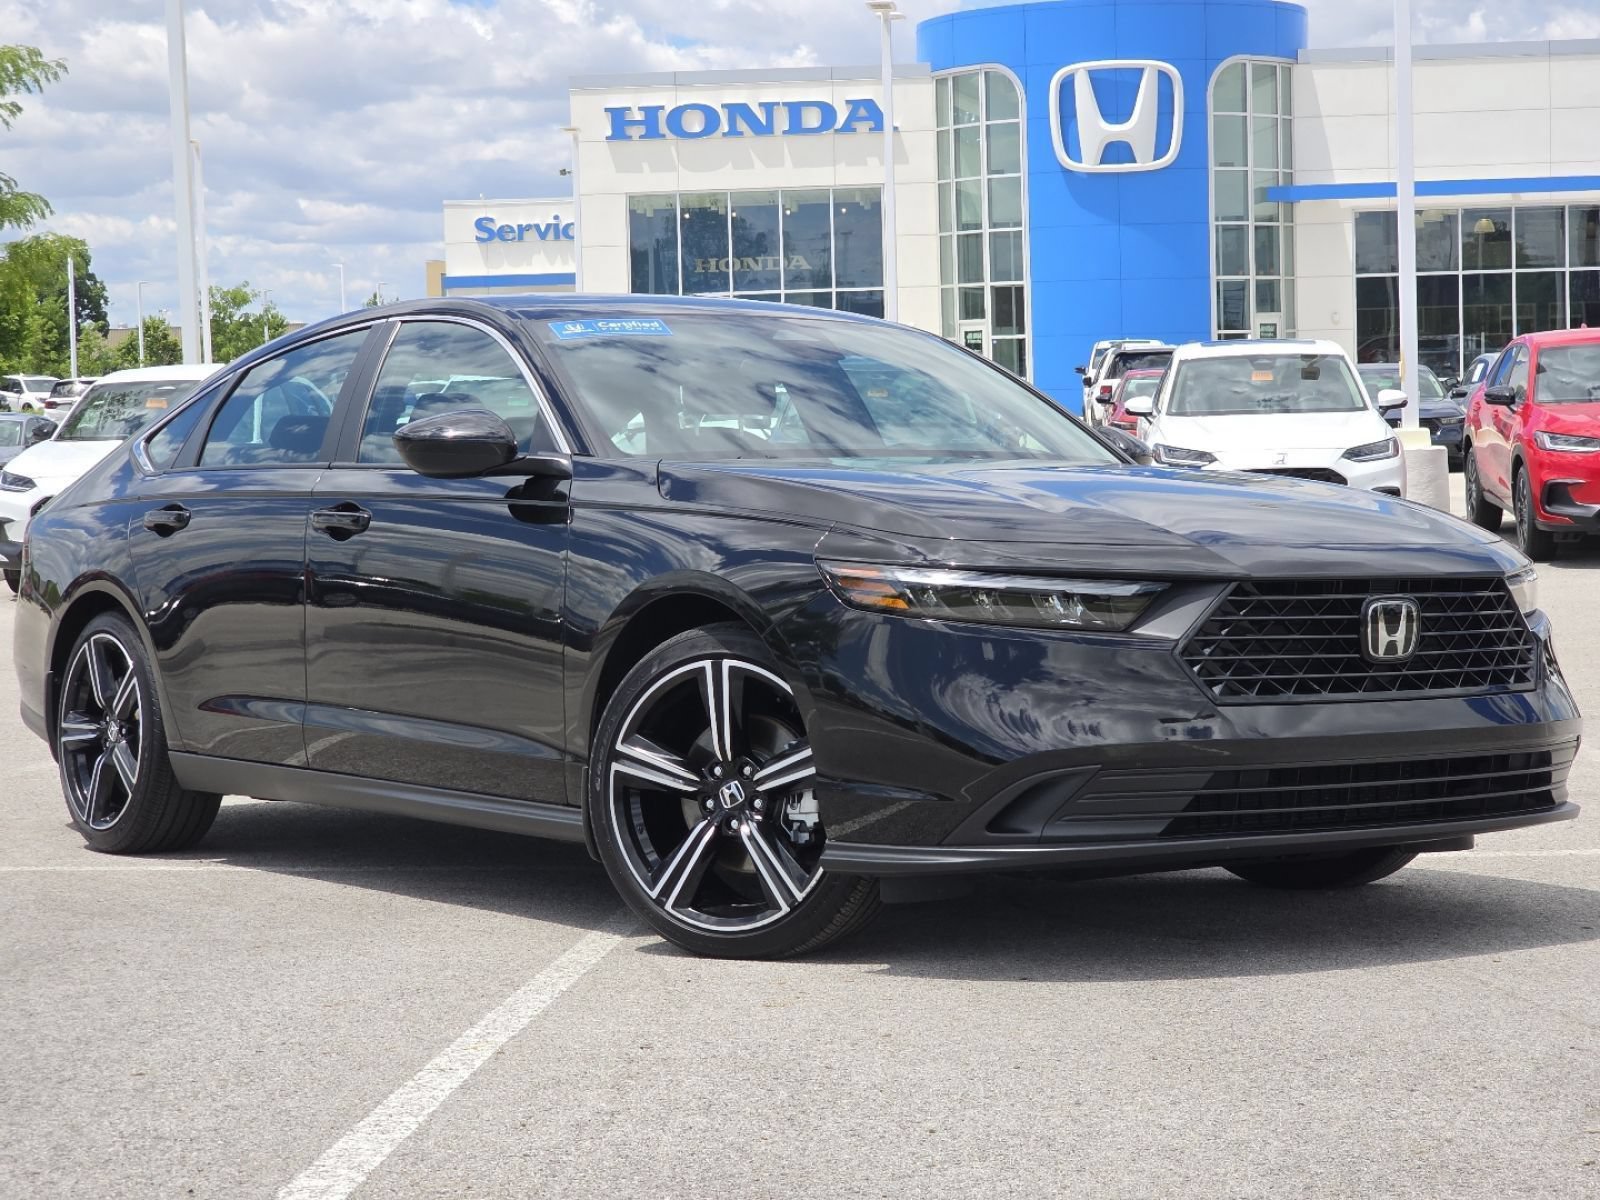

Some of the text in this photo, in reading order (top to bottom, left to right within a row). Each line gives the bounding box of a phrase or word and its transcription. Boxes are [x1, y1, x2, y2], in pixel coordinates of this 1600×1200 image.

[604, 98, 898, 141] HONDA
[474, 214, 575, 242] Servic
[694, 255, 813, 273] HONDA
